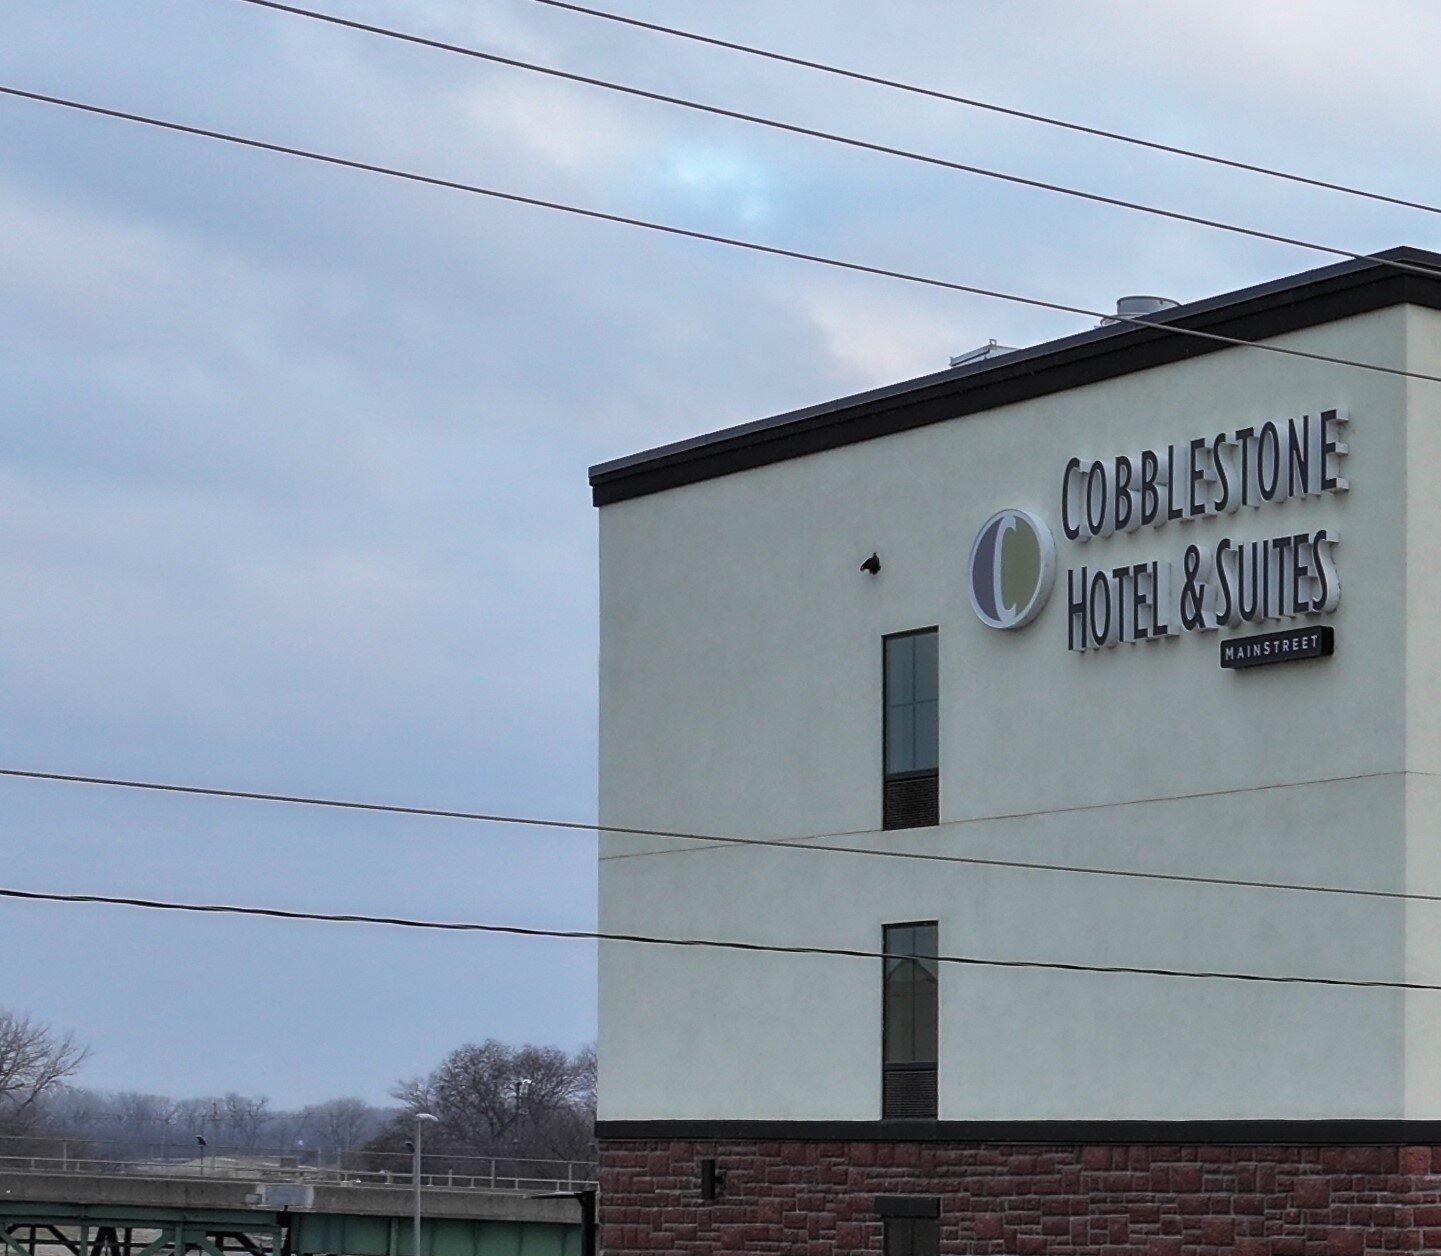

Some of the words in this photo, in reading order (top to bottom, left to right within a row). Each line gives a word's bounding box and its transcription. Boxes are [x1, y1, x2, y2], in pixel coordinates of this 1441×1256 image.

[1062, 409, 1348, 541] COBBLESTONE
[1067, 561, 1178, 652] HOTEL
[1180, 544, 1214, 632] &
[1215, 529, 1341, 628] SUITES
[1225, 634, 1319, 661] MAINSTREET
